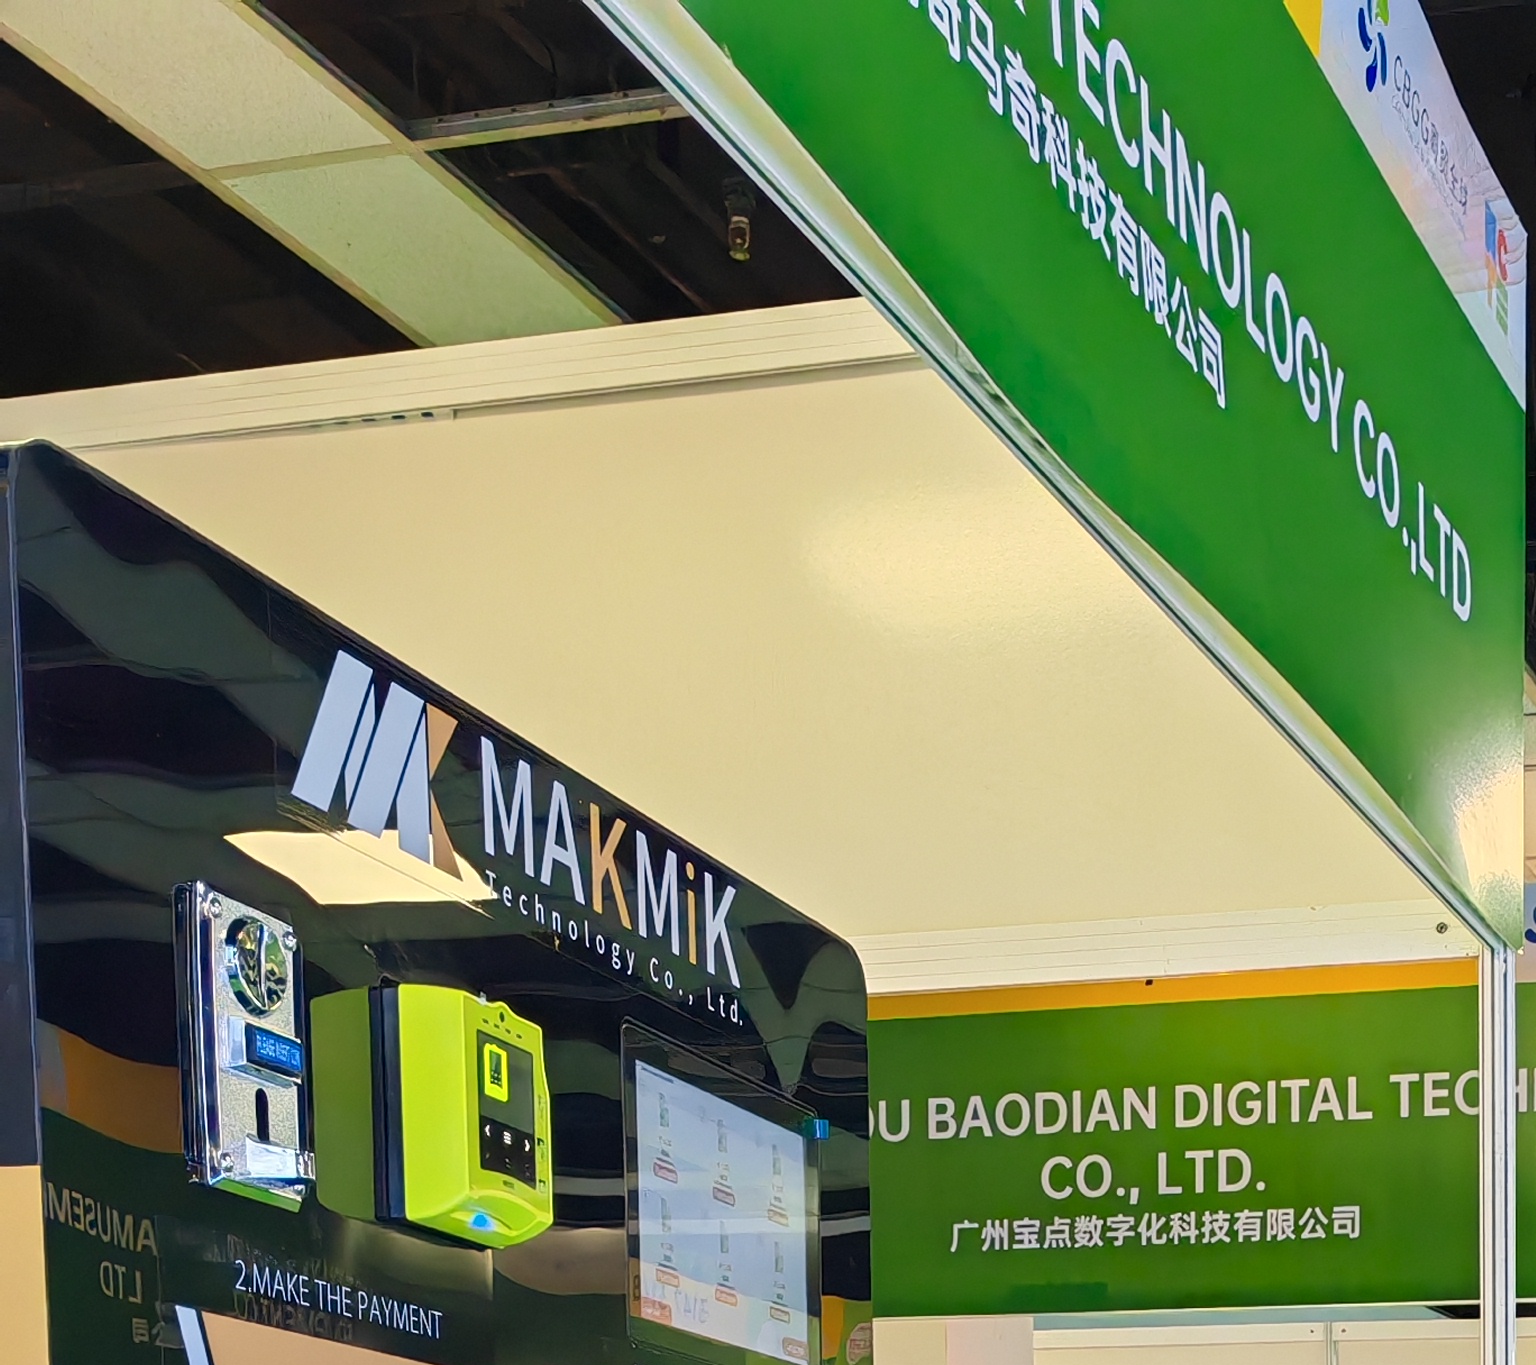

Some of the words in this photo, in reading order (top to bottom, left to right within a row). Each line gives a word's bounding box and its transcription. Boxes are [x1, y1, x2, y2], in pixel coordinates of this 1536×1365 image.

[485, 869, 637, 976] Technology
[649, 963, 693, 1011] Co.,
[706, 990, 745, 1027] Ltd.
[927, 1086, 1157, 1141] BAODIAN
[1175, 1075, 1373, 1129] DIGITAL
[1041, 1155, 1139, 1204] CO.,
[1158, 1149, 1266, 1196] LTD.
[950, 1204, 1362, 1252] 广州宝点数字化科技有限公司
[234, 1259, 310, 1308] 2.MAKE
[315, 1279, 353, 1318] THE
[358, 1290, 442, 1340] PAYMENT
